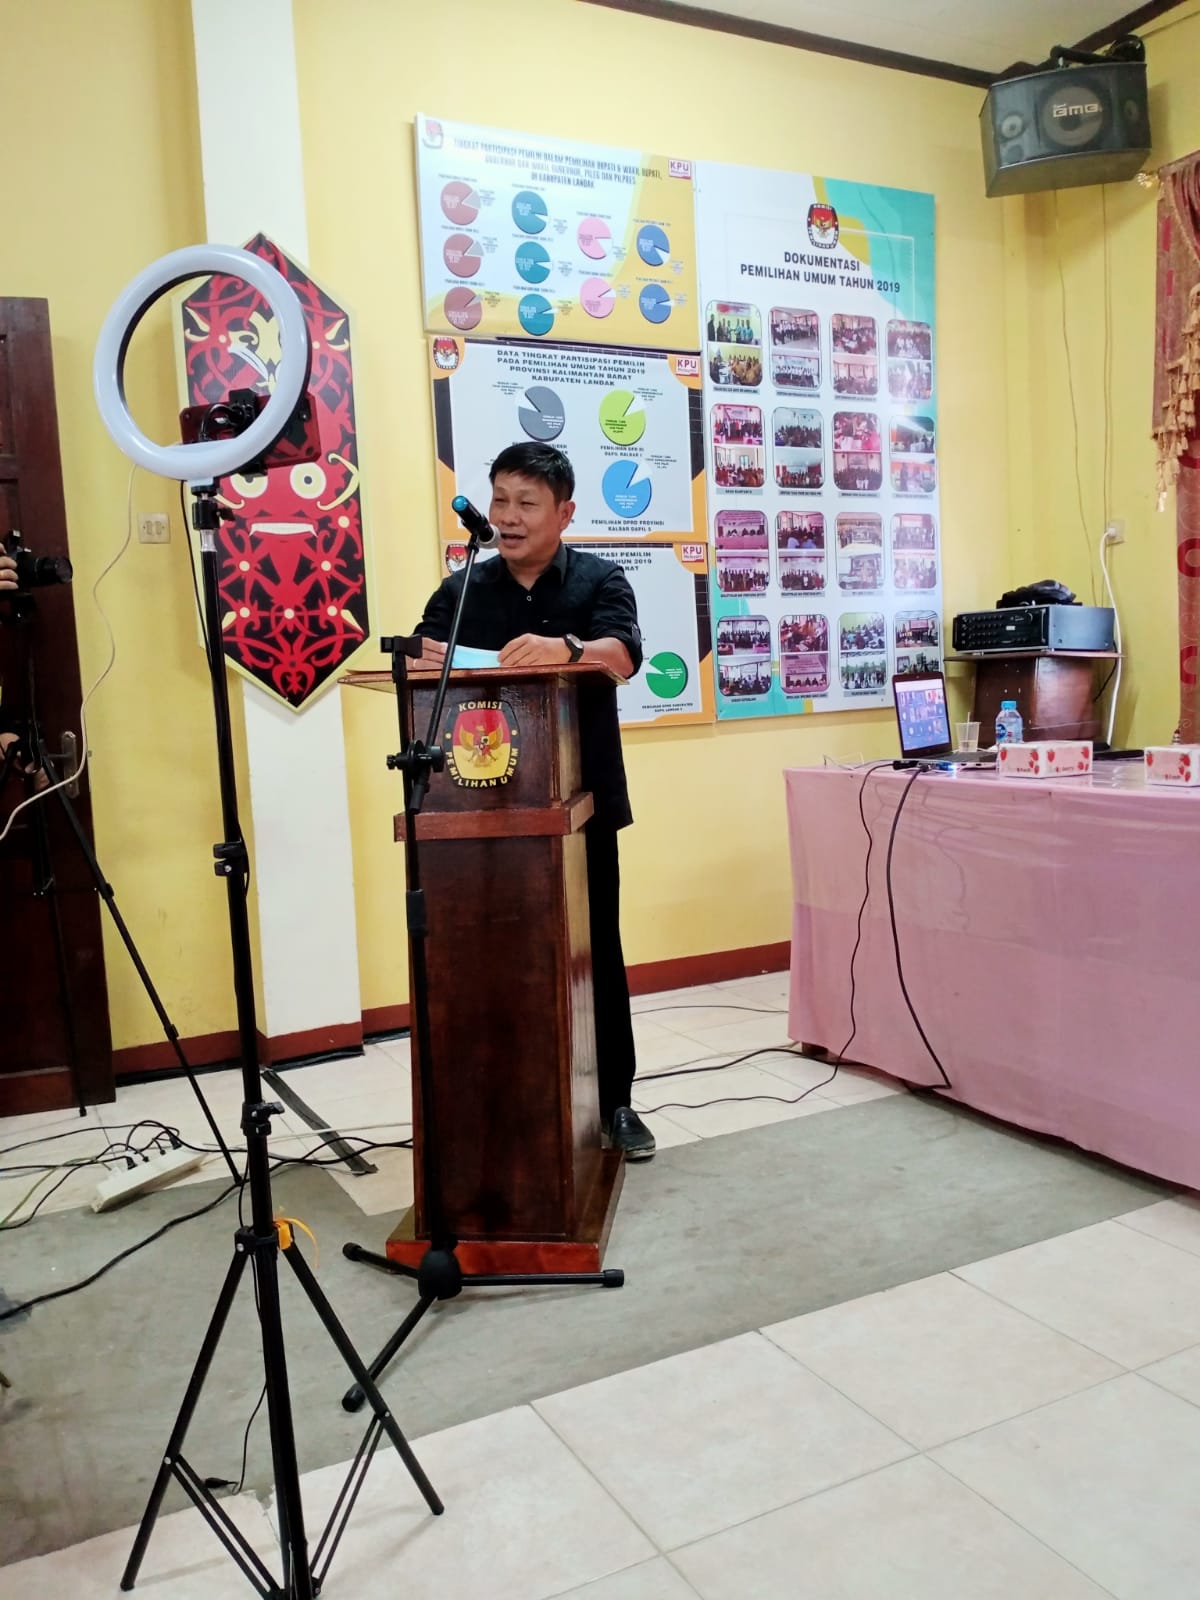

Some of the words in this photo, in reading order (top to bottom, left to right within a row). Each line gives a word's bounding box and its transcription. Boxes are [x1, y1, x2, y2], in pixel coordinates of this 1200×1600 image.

[670, 161, 689, 172] KPU
[784, 251, 860, 271] DOKUMENTASI
[740, 264, 800, 281] PEMILIHAN
[804, 271, 836, 285] UMUM
[839, 275, 874, 290] TAHUN
[877, 280, 900, 293] 2019
[497, 349, 519, 357] DATA
[522, 351, 558, 360] TINGKAT
[560, 355, 610, 365] PARTISIPASI
[613, 359, 645, 367] PEMILIH
[677, 359, 697, 369] KPU
[509, 365, 550, 375] PROVINSI
[552, 368, 605, 379] KALIMANTAN
[523, 359, 568, 368] PEMILIHAN
[598, 365, 625, 373] TAHUN
[531, 375, 581, 384] KABUPATEN
[683, 546, 702, 554] KPU
[459, 701, 502, 712] KOMISI
[446, 751, 497, 787] PEMILIHAN
[500, 748, 519, 784] UMUM
